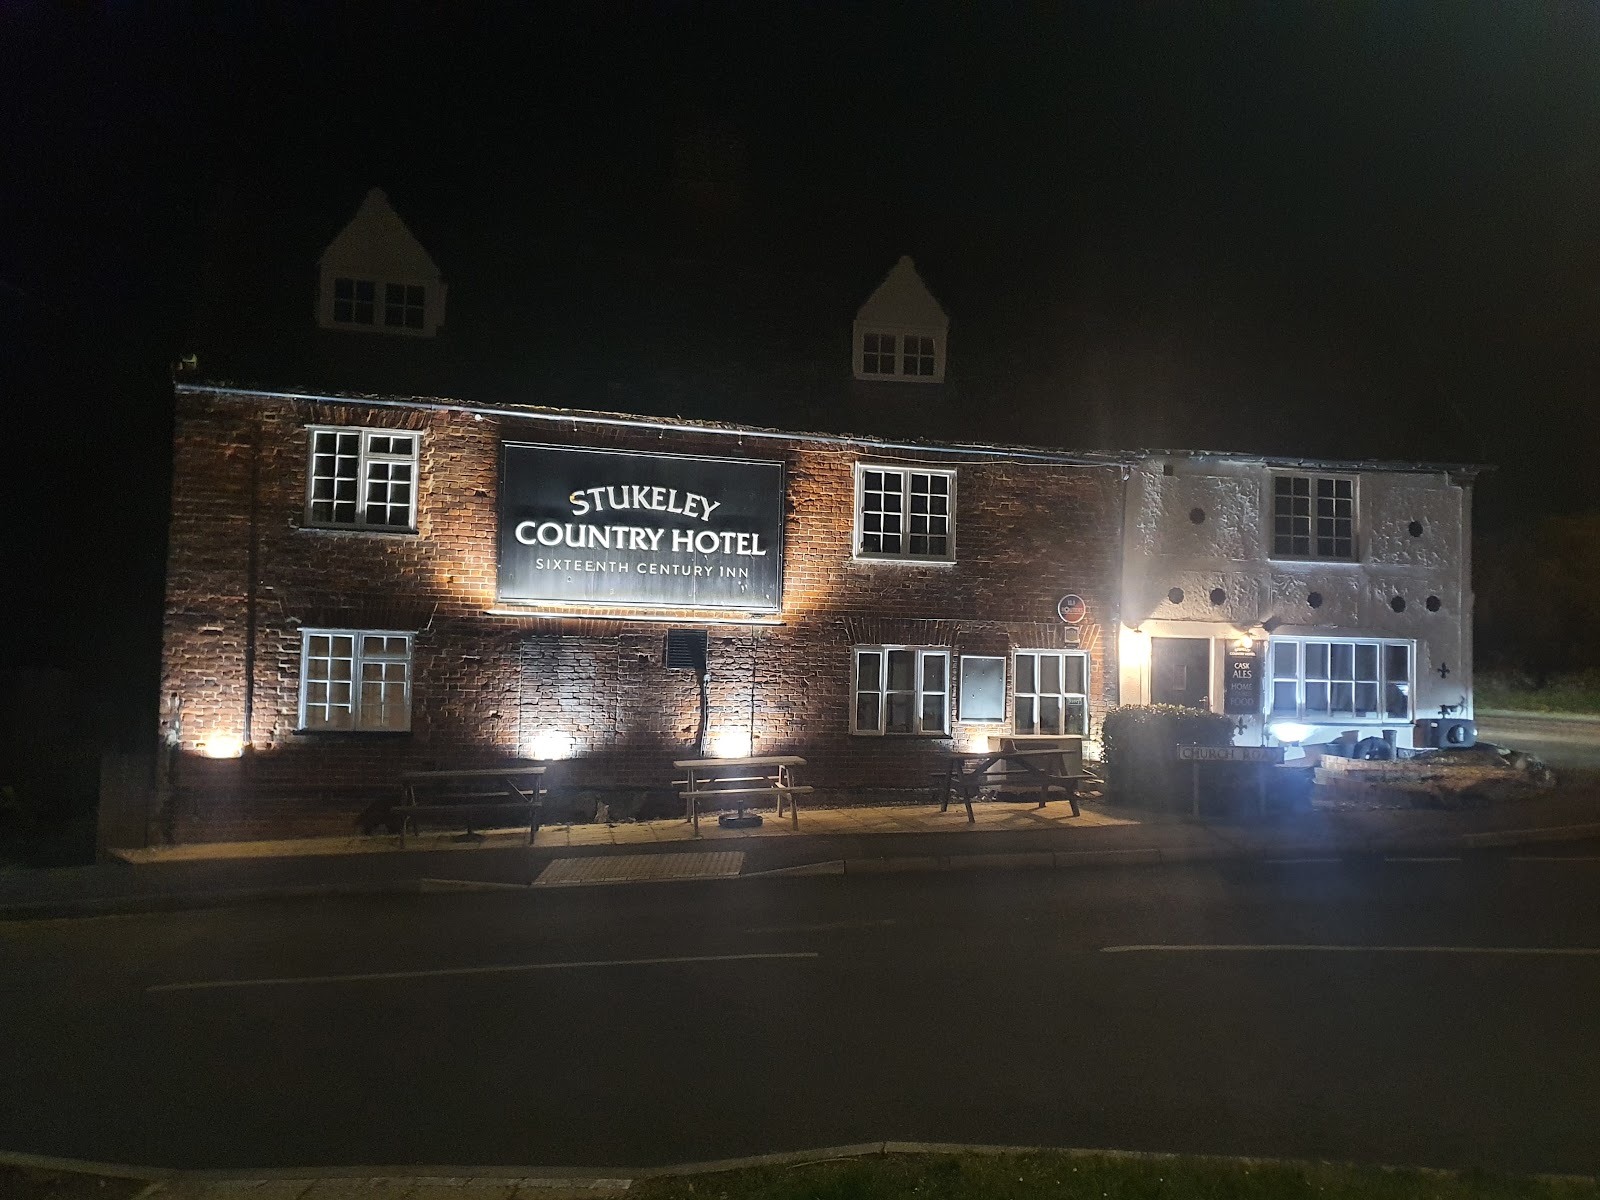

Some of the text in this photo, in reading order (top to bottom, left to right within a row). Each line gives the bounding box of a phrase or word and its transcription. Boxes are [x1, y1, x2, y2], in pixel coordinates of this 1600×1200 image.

[569, 485, 721, 521] STUKELEY
[515, 521, 766, 556] COUNTRY HOTEL
[536, 558, 749, 579] SIXTEENTH CENTURY INN
[1233, 670, 1252, 679] ALES
[1231, 683, 1253, 691] HOME
[1183, 748, 1234, 760] CHURCH
